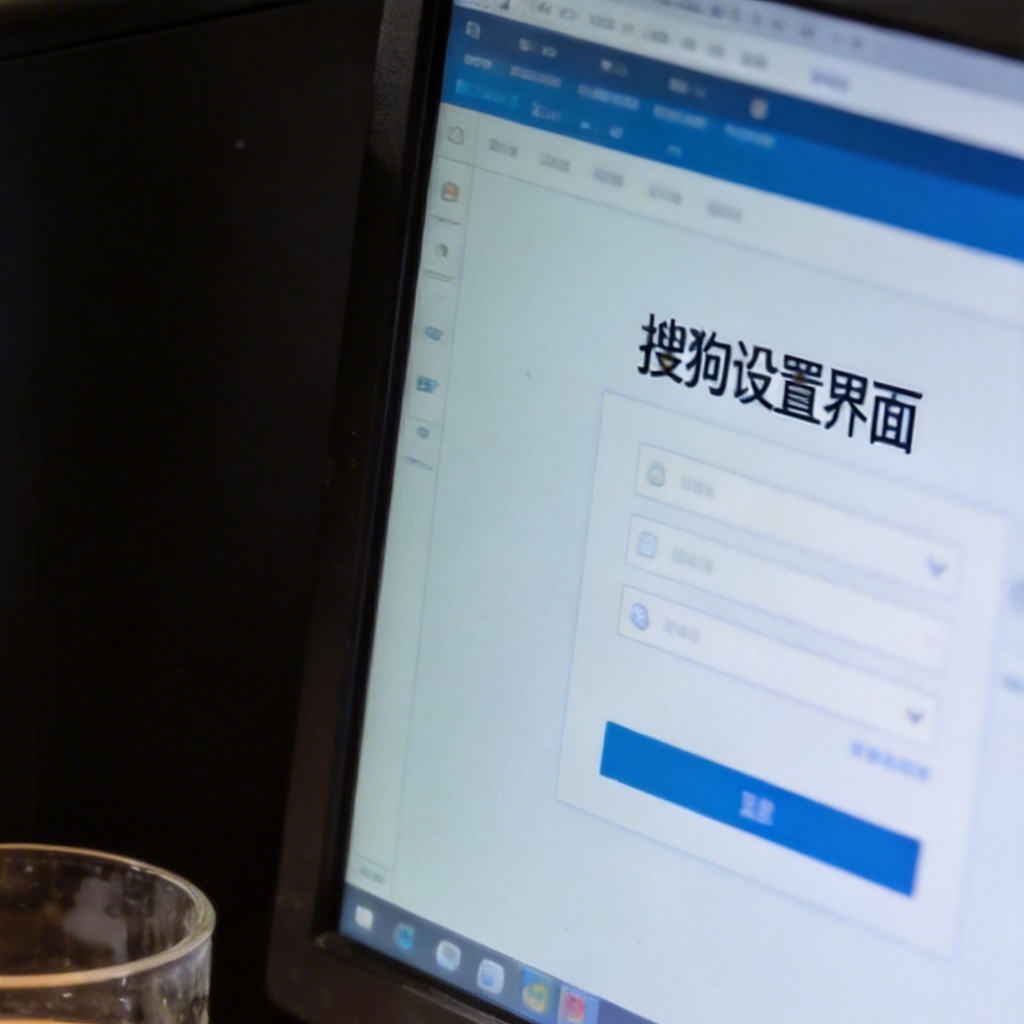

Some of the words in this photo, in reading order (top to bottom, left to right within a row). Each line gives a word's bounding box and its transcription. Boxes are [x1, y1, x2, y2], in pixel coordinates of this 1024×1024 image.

[638, 313, 923, 454] 搜狗设置界面
